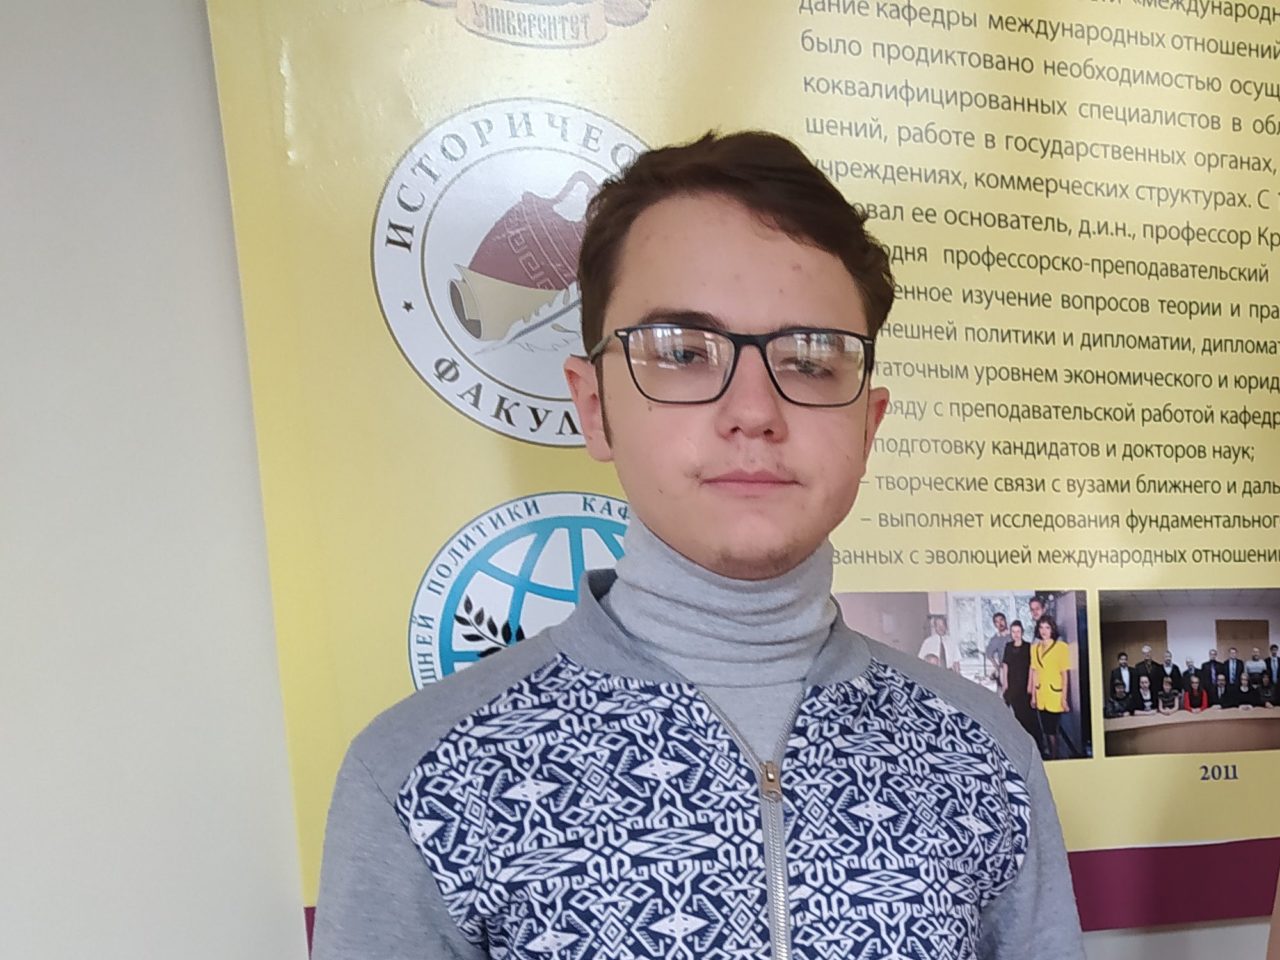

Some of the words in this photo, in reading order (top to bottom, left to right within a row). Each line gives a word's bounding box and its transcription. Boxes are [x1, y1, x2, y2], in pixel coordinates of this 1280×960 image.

[876, 0, 977, 31] кафедры
[988, 13, 1165, 48] международных
[801, 28, 861, 56] было
[873, 42, 1034, 73] продиктовано
[1043, 58, 1221, 92] необходимостью
[804, 76, 1067, 116] коквалифицированных
[1078, 102, 1221, 130] специалистов
[1232, 116, 1242, 132] в
[806, 117, 887, 143] шений,
[898, 121, 975, 148] работе
[984, 133, 995, 149] в
[1005, 134, 1185, 165] государственных
[1194, 151, 1276, 176] органах,
[974, 171, 1129, 199] коммерческих
[1135, 185, 1251, 211] структурах.
[1257, 189, 1269, 209] С
[911, 206, 937, 224] ее
[944, 208, 1072, 236] основатель,
[1078, 219, 1135, 240] д.и.н.,
[1143, 220, 1251, 250] профессор
[943, 244, 1268, 283] профессорско-преподавательский
[894, 284, 953, 303] енное
[962, 288, 1052, 310] изучение
[1061, 293, 1150, 316] вопросов
[1157, 298, 1221, 320] теории
[1230, 302, 1240, 318] и
[880, 320, 957, 341] нешней
[965, 326, 1055, 346] политики
[1062, 331, 1074, 346] и
[1080, 332, 1195, 355] дипломатии,
[874, 361, 969, 379] таточным
[974, 365, 1058, 386] уровнем
[1063, 368, 1212, 389] экономического
[1218, 374, 1228, 389] и
[433, 354, 583, 438] ФАКУЛ
[933, 401, 943, 417] с
[949, 402, 1135, 423] преподавательской
[1141, 402, 1214, 427] работой
[874, 438, 984, 462] подготовку
[991, 440, 1100, 460] кандидатов
[1106, 443, 1116, 457] и
[1121, 443, 1207, 463] докторов
[1212, 444, 1254, 464] наук;
[875, 475, 988, 496] творческие
[994, 476, 1045, 492] связи
[1051, 478, 1060, 493] с
[1066, 478, 1130, 498] вузами
[1136, 473, 1221, 494] ближнего
[1226, 480, 1237, 494] и
[582, 495, 630, 520] КАФ
[878, 512, 984, 528] выполняет
[990, 513, 1120, 532] исследования
[426, 499, 541, 596] ПОЛИТИКИ
[909, 550, 919, 564] с
[925, 544, 1031, 568] эволюцией
[1037, 549, 1187, 569] международных
[1199, 764, 1239, 781] 2011
